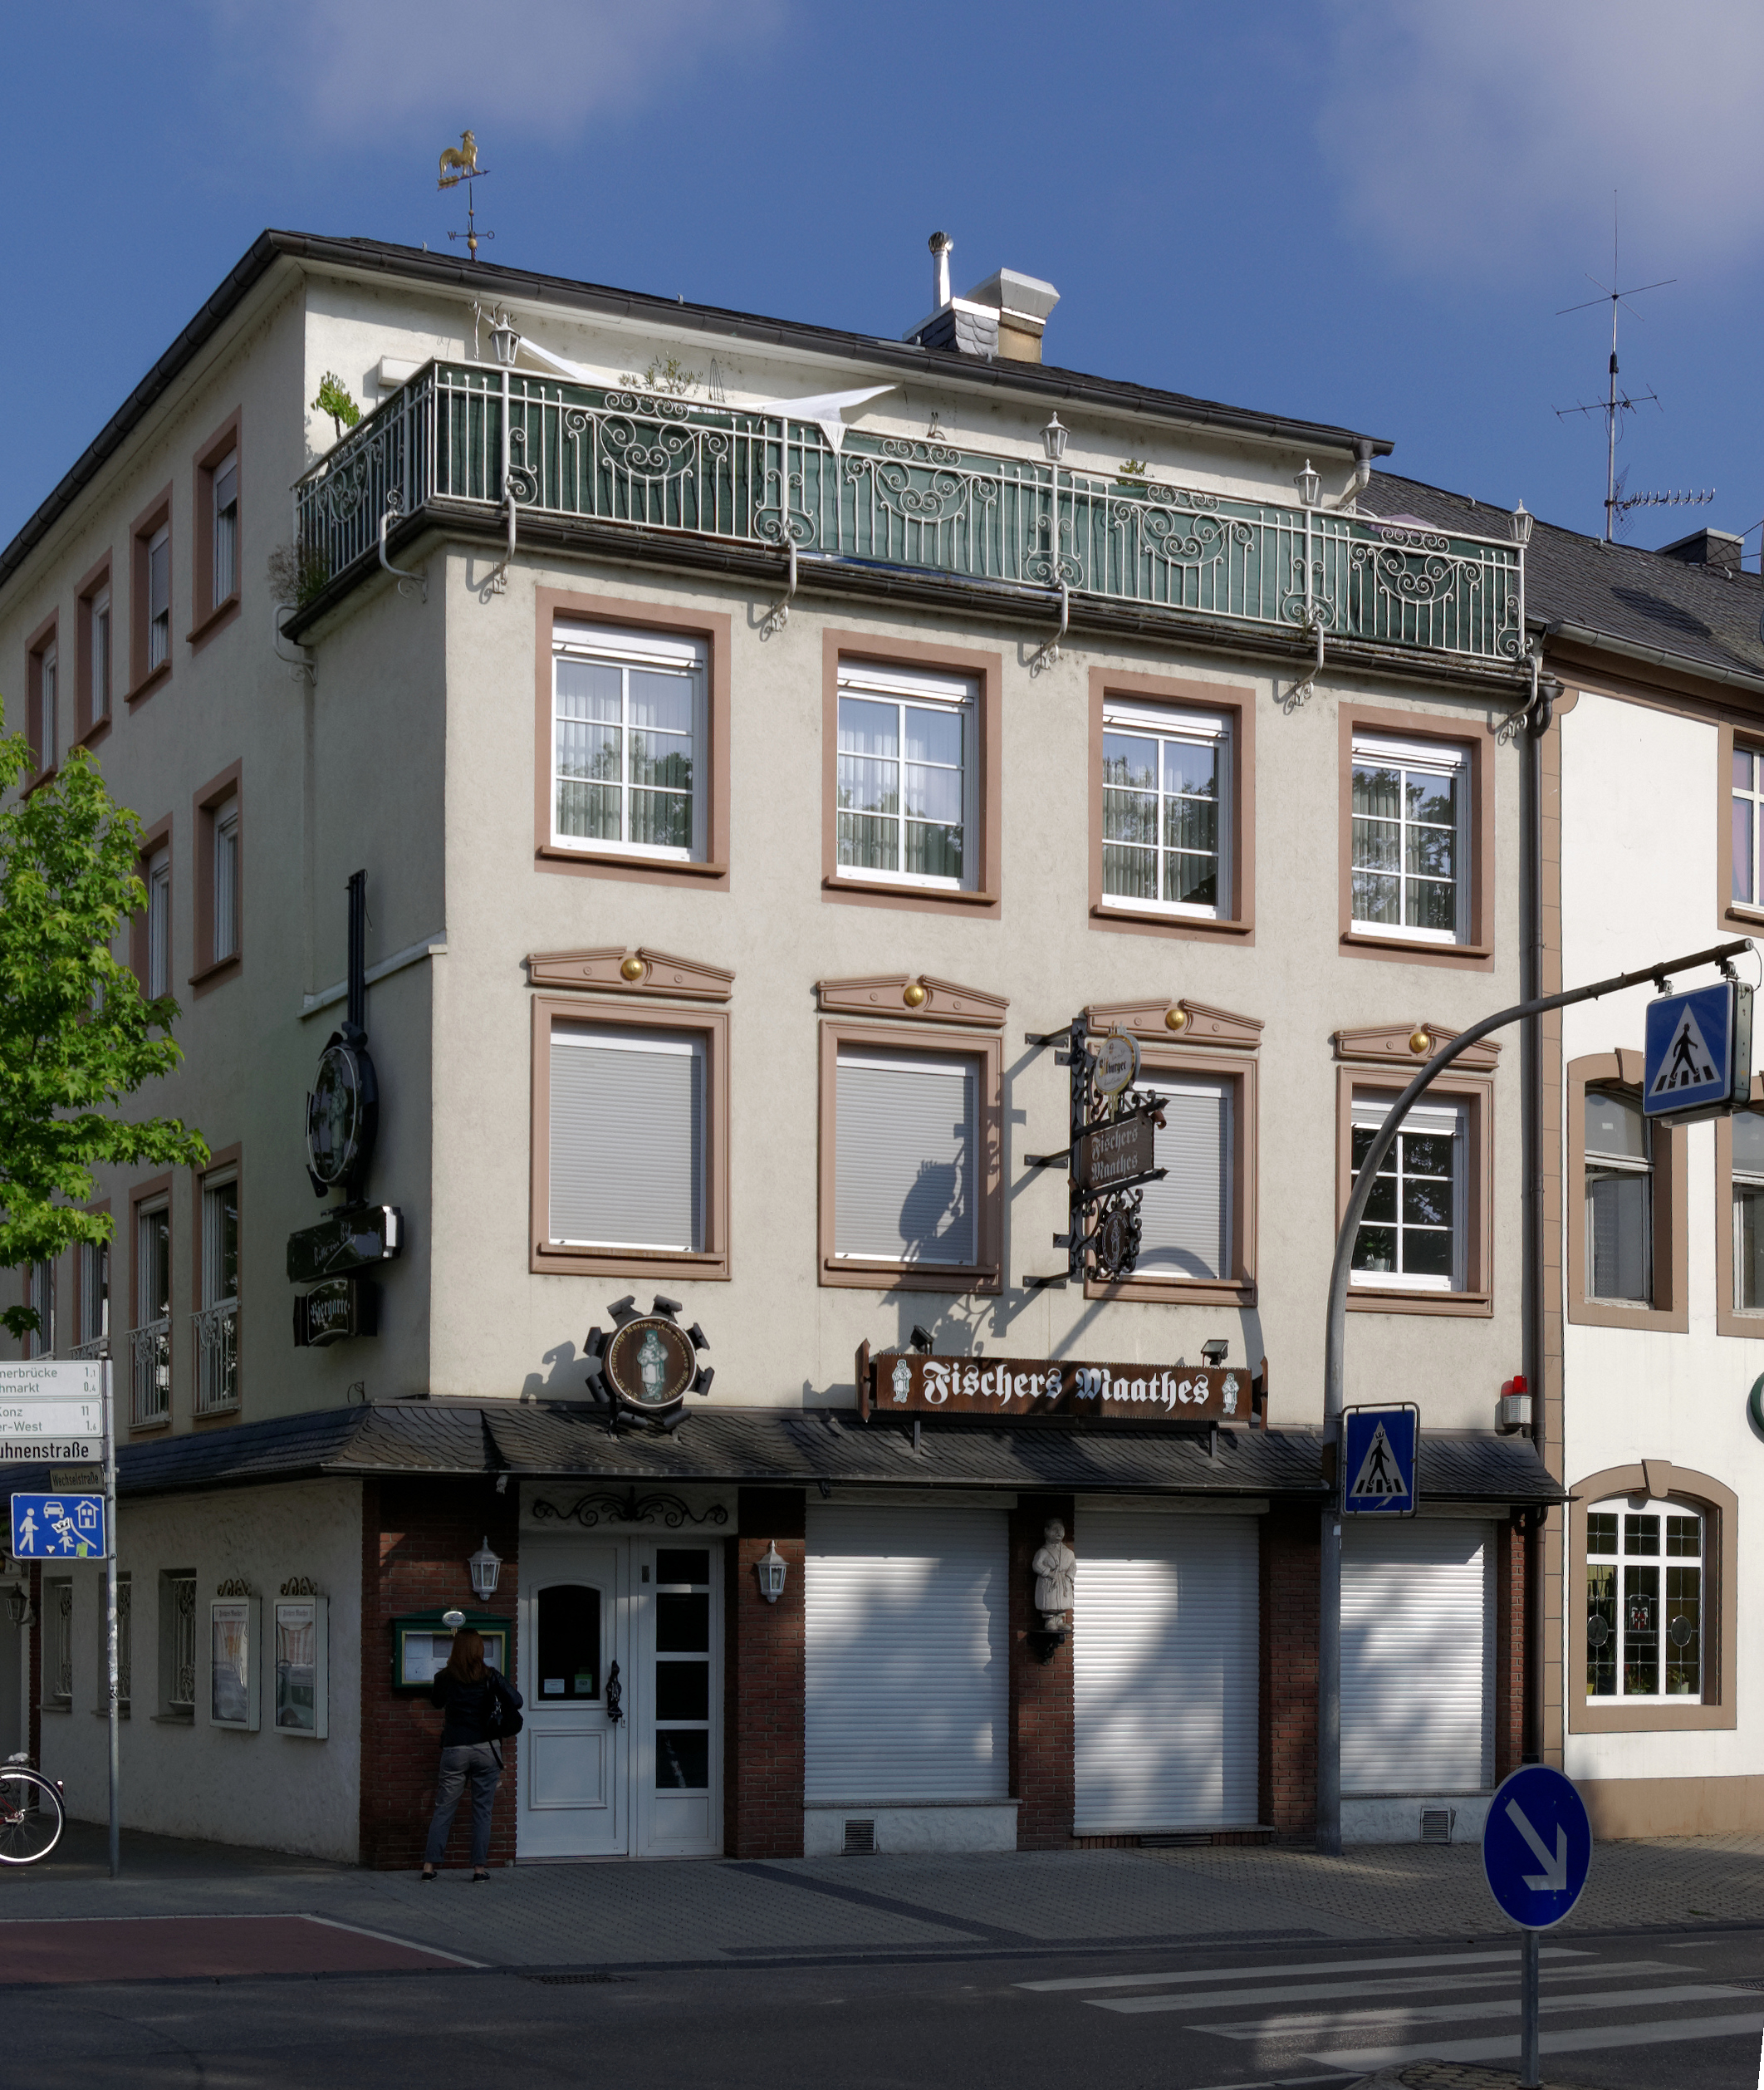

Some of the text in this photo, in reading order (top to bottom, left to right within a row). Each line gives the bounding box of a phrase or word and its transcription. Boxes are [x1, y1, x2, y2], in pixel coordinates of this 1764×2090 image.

[1091, 1125, 1139, 1161] Fischers
[1091, 1153, 1139, 1181] Maathes
[923, 1361, 1209, 1413] Fischers Maathes
[0, 1406, 90, 1417] onz 11
[0, 1421, 42, 1432] r-West
[52, 1472, 99, 1487] Wechselstraße
